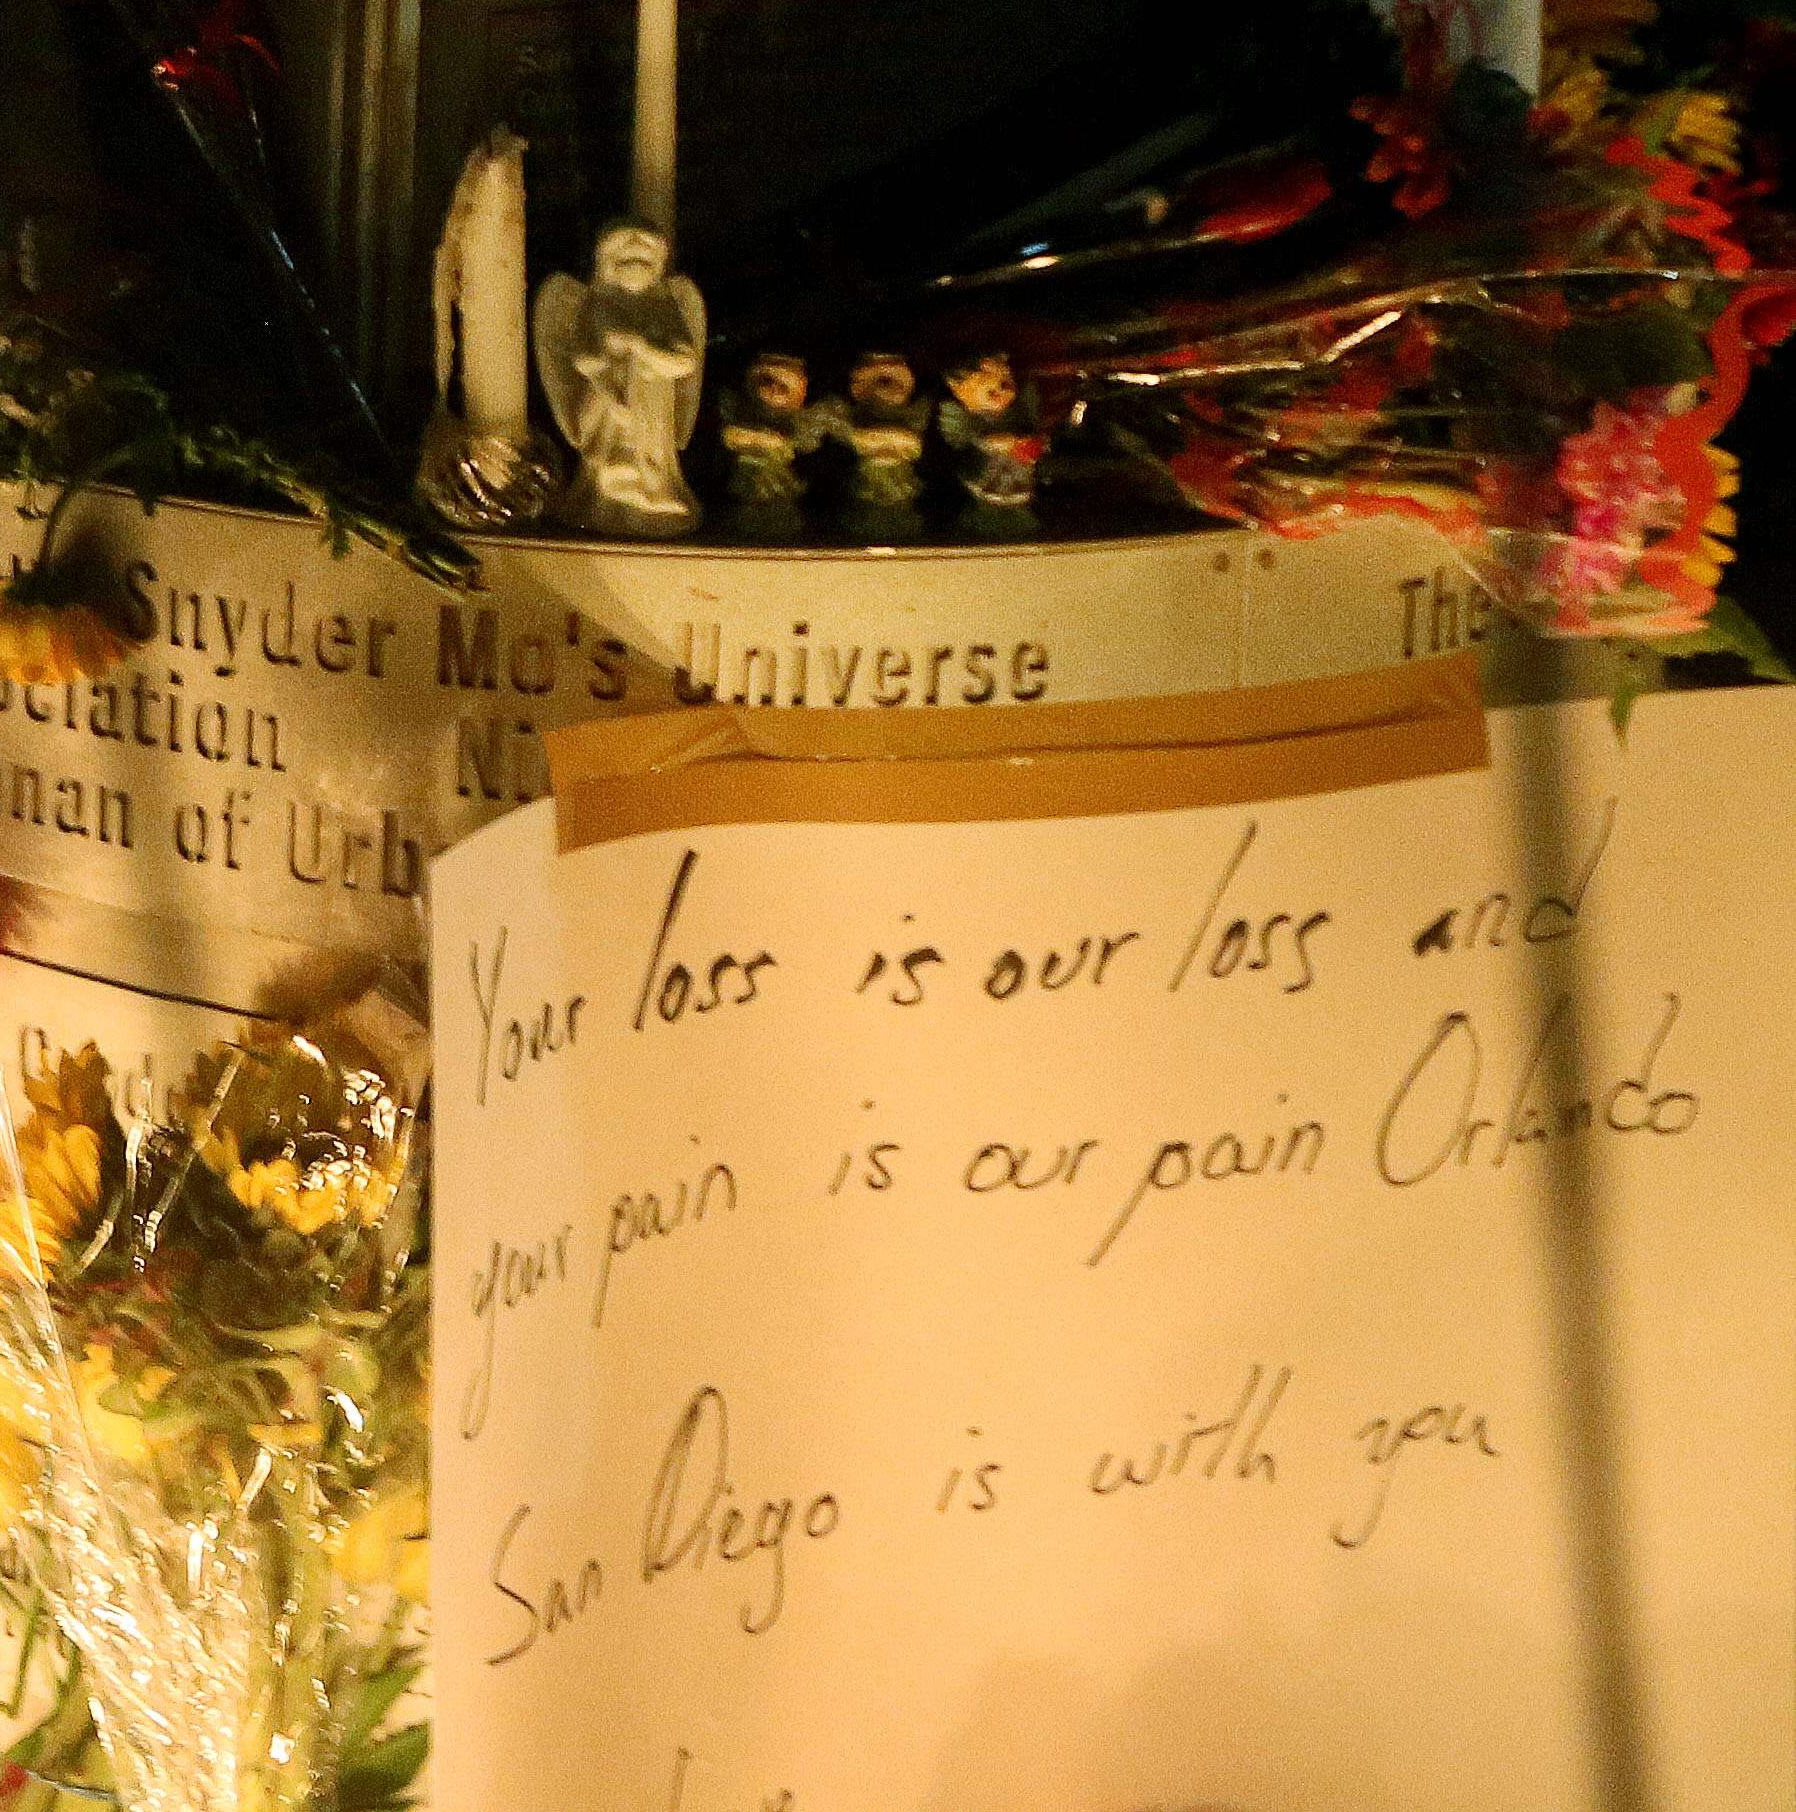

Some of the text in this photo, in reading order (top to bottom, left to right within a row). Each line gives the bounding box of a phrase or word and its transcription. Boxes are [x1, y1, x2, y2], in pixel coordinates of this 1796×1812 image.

[124, 560, 397, 680] Snyder
[437, 602, 1053, 709] Mo's Universe
[173, 788, 251, 874] of
[467, 794, 1621, 1108] Your loss is our loss and
[460, 990, 1703, 1444] your pain is our pain Orlando
[485, 1363, 1506, 1666] San Diego is with you
